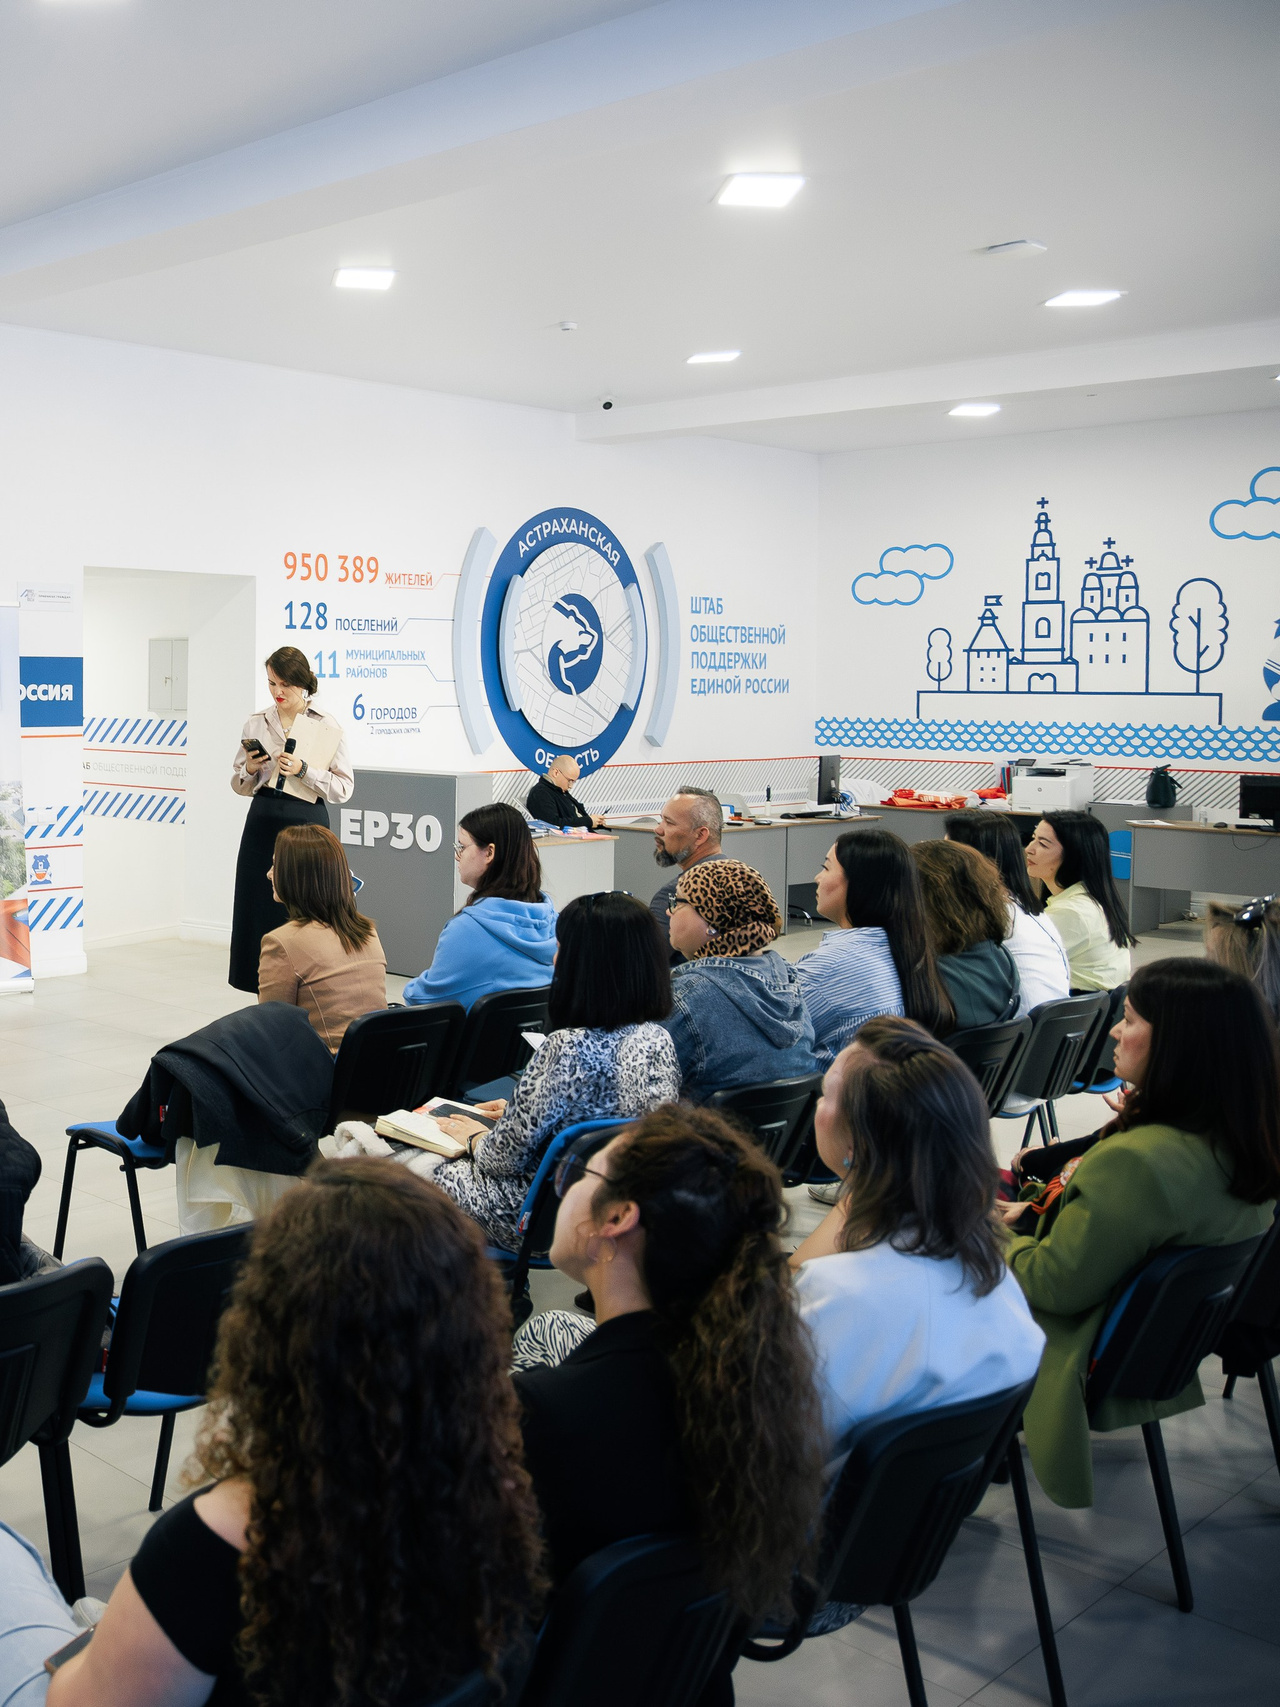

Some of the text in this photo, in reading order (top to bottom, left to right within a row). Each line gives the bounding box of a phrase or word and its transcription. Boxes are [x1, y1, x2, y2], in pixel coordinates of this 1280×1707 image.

[517, 517, 622, 568] АСТРАХАНСКАЯ
[283, 551, 434, 587] 950 389 ЖИТЕЛЕЙ
[284, 600, 399, 633] 128 ПОСЕЛЕНИЙ
[690, 596, 724, 616] ШТАБ
[690, 624, 787, 646] ОБЩЕСТВЕННОЙ
[314, 650, 341, 679] 11
[345, 649, 427, 662] МУНИЦИПАЛЬНЫХ
[690, 652, 768, 671] ПОДДЕРЖКИ
[345, 666, 389, 679] РАЙОНОВ
[20, 683, 74, 701] ОССИЯ
[690, 676, 790, 696] ЕДИНОЙ РОССИИ
[352, 693, 418, 721] 6 ГОРОДОВ
[535, 748, 600, 769] ОБСТЬ
[340, 808, 443, 853] ЕР30
